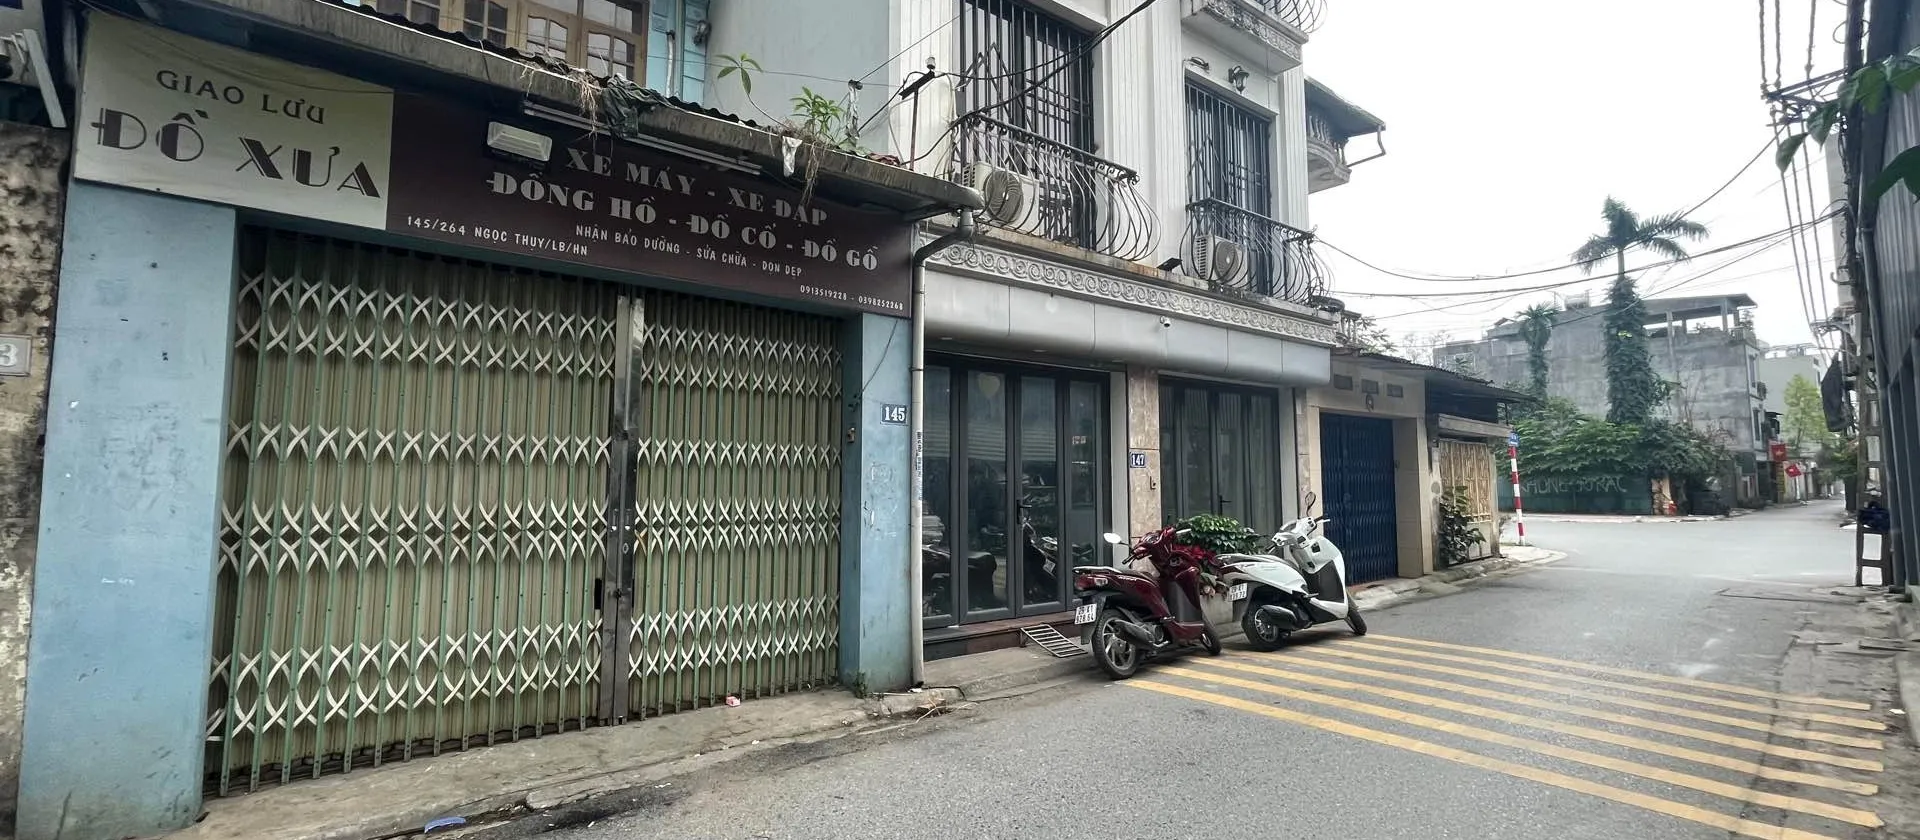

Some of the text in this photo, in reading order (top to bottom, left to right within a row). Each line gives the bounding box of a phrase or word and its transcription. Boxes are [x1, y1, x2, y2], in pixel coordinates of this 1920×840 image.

[156, 70, 325, 124] GIAO LƯU
[91, 107, 381, 198] ĐỒ XƯA
[566, 147, 612, 176] XE
[625, 162, 696, 196] MÁY
[728, 186, 764, 212] XE
[772, 199, 827, 227] ĐẠP
[407, 216, 466, 236] 145/264
[474, 227, 507, 244] NGỌC
[486, 171, 594, 211] ĐỒNG
[609, 196, 657, 224] HỒ
[686, 214, 730, 239] ĐỒ
[741, 223, 777, 249] CỔ
[801, 238, 837, 262] ĐỒ
[846, 246, 878, 270] GỖ
[576, 224, 608, 242] NHẬN
[615, 229, 637, 246] BẢO
[644, 236, 680, 254] DƯỠNG
[800, 284, 847, 301] 0913519228
[884, 406, 906, 422] 145
[1132, 454, 1145, 466] 147
